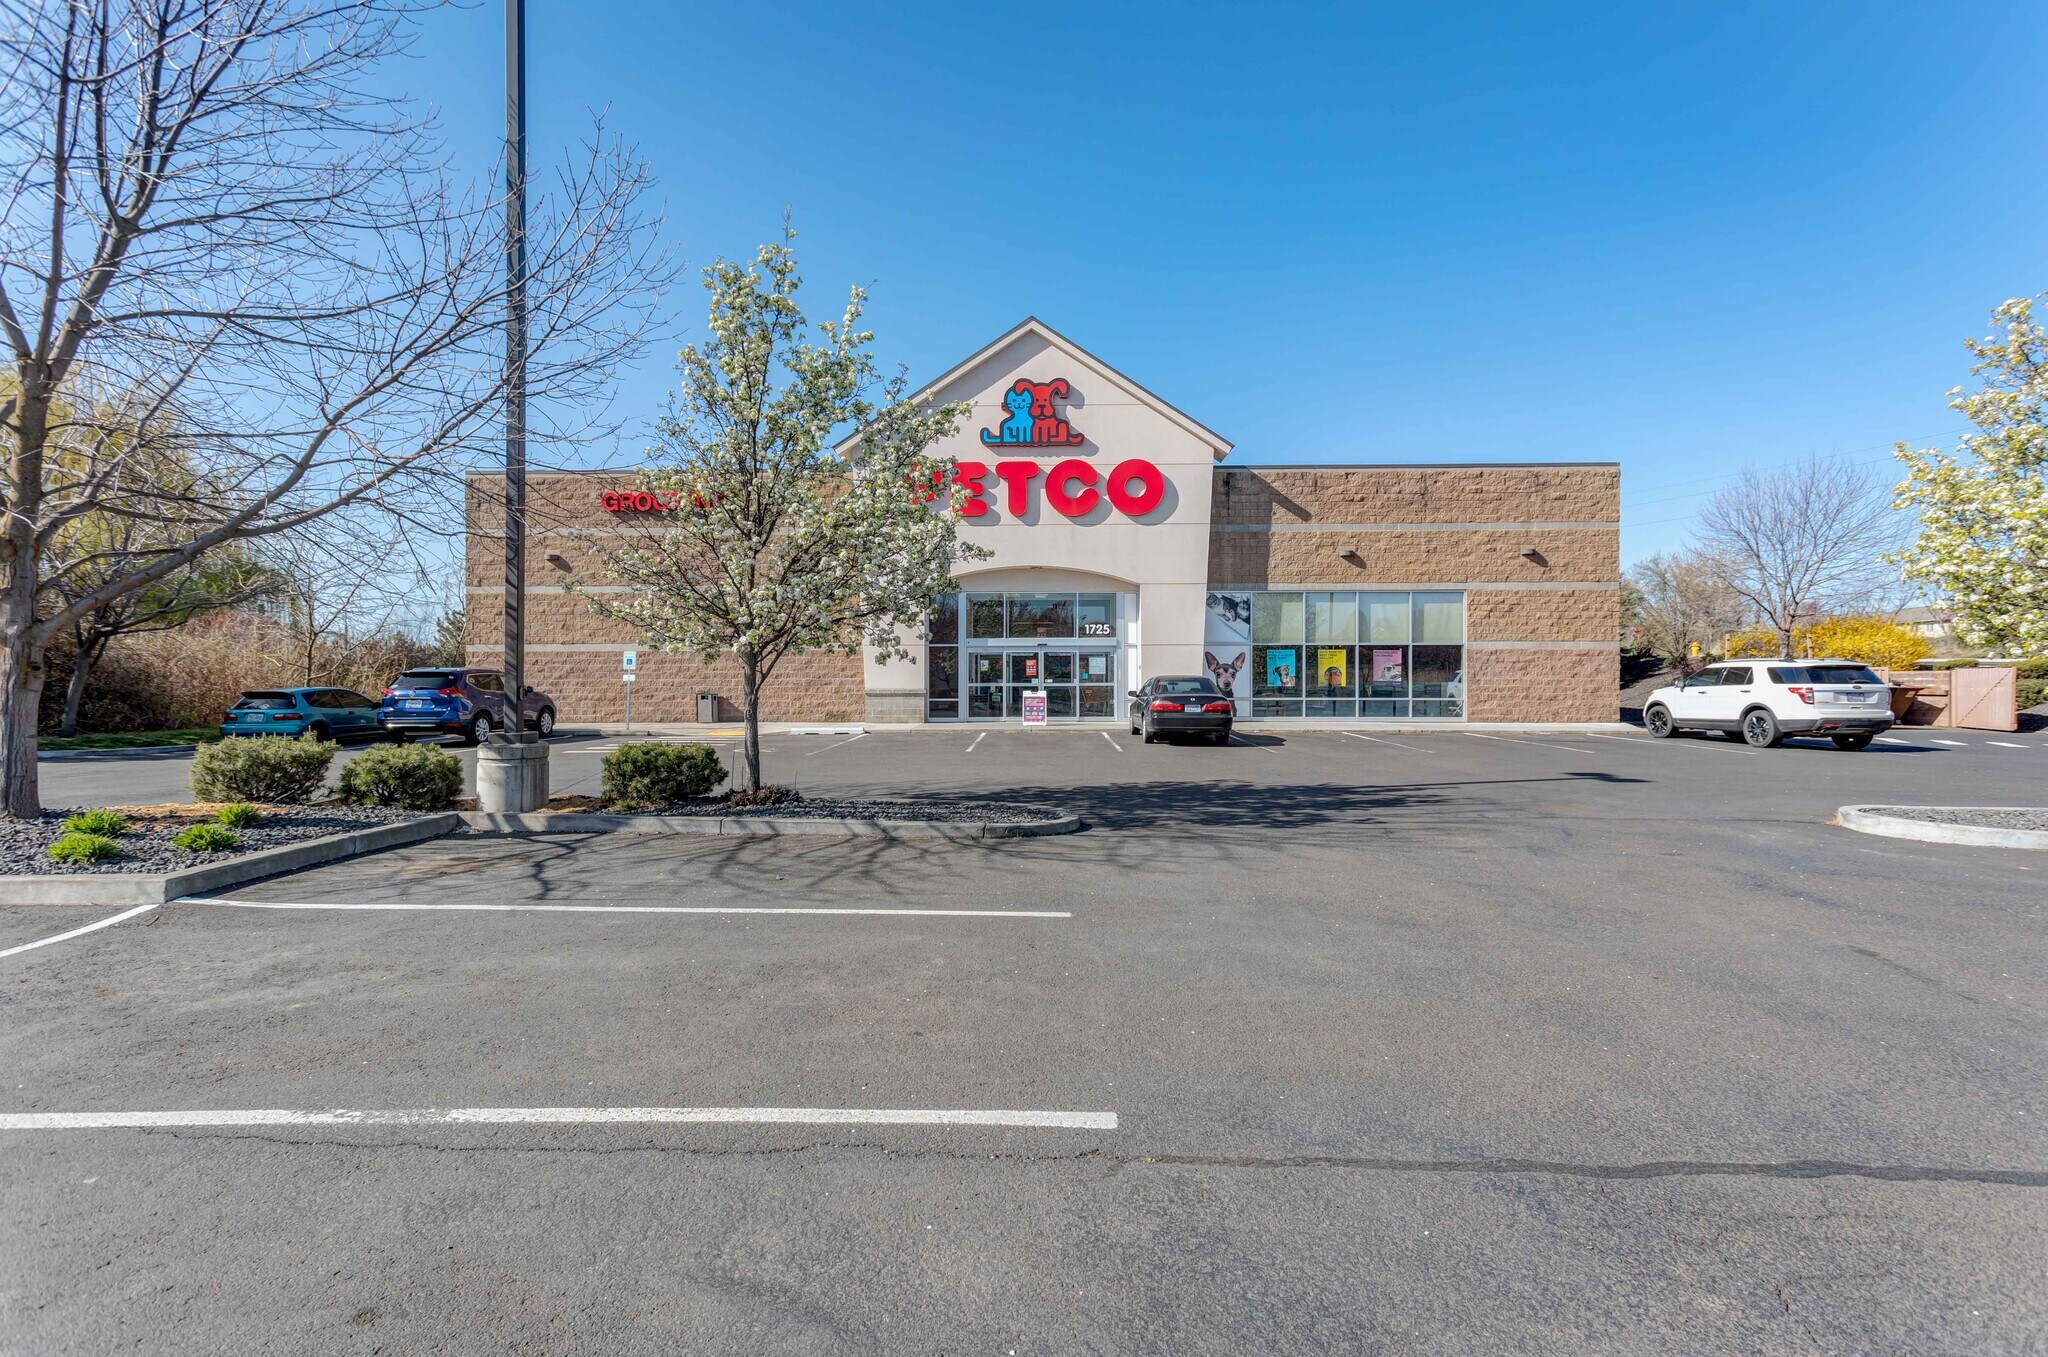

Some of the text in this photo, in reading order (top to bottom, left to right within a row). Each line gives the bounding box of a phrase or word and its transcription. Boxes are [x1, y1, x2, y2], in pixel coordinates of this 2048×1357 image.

[904, 458, 1165, 517] ETCO
[602, 491, 726, 512] GROO
[1084, 623, 1111, 635] 1725
